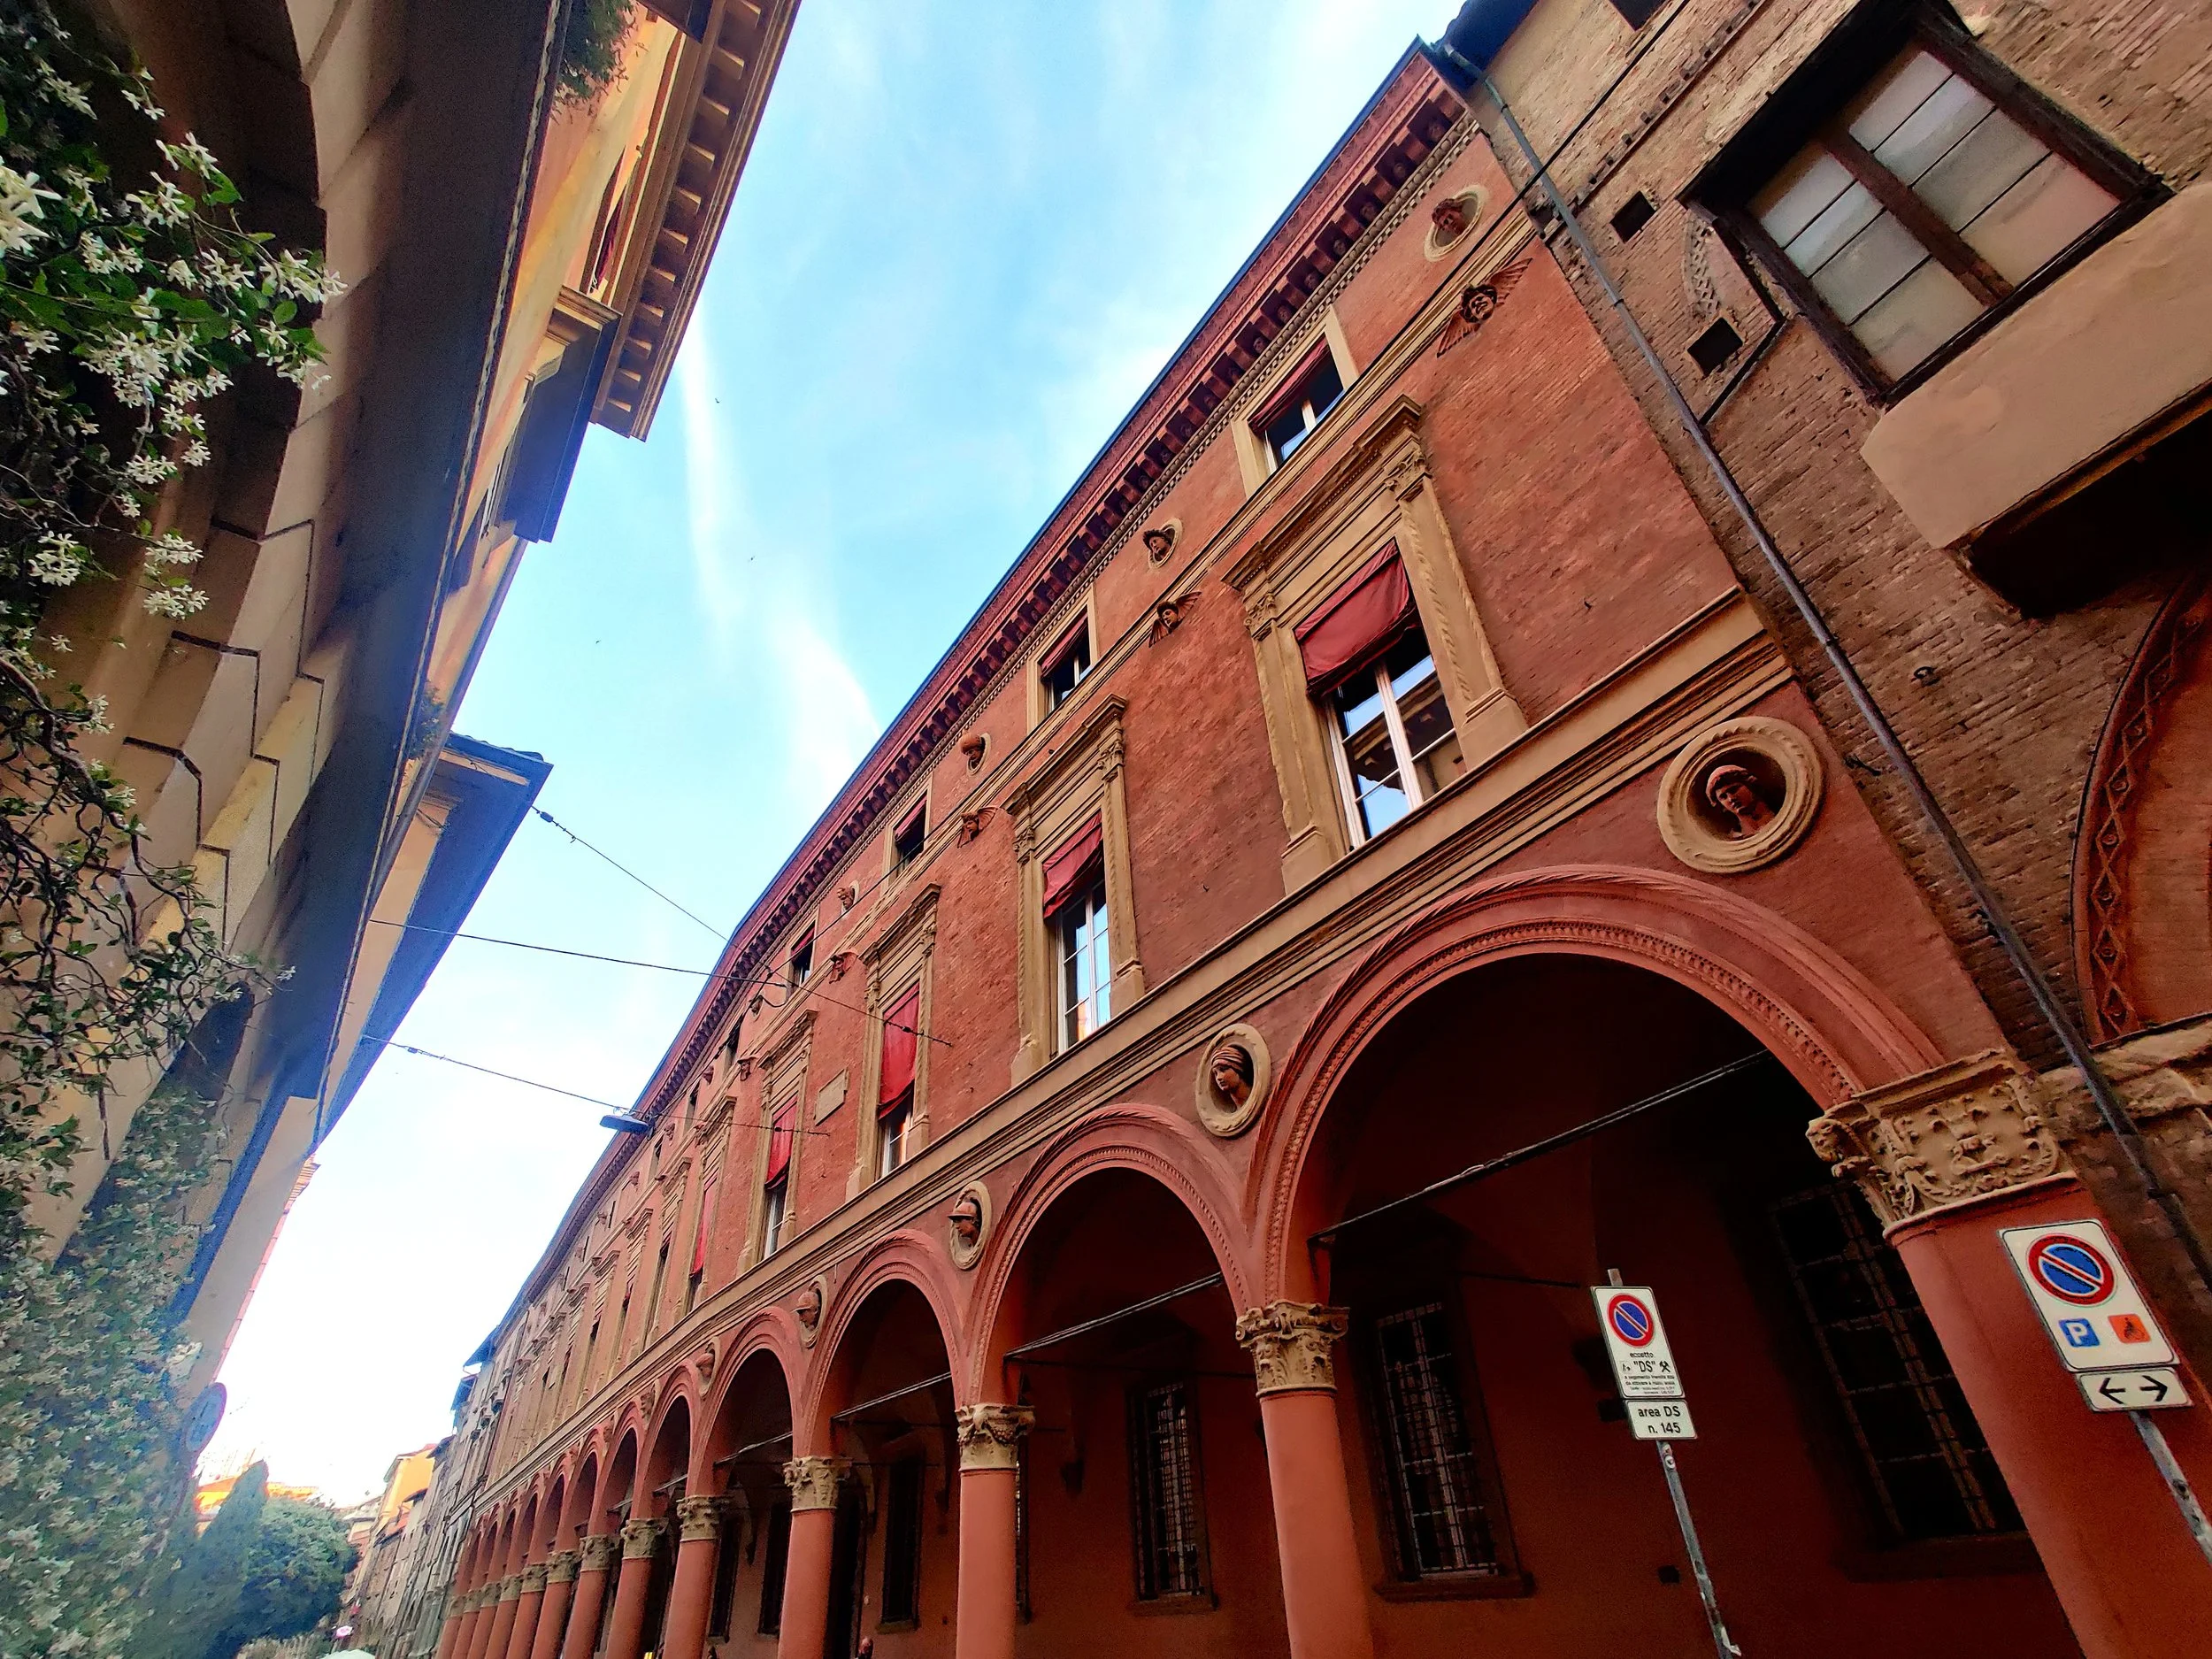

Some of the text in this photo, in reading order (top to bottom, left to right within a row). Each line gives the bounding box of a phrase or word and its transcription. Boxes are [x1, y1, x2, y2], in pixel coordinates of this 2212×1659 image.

[2066, 1322, 2089, 1345] P
[1638, 1405, 1681, 1417] area DS
[1647, 1422, 1681, 1434] n. 145
